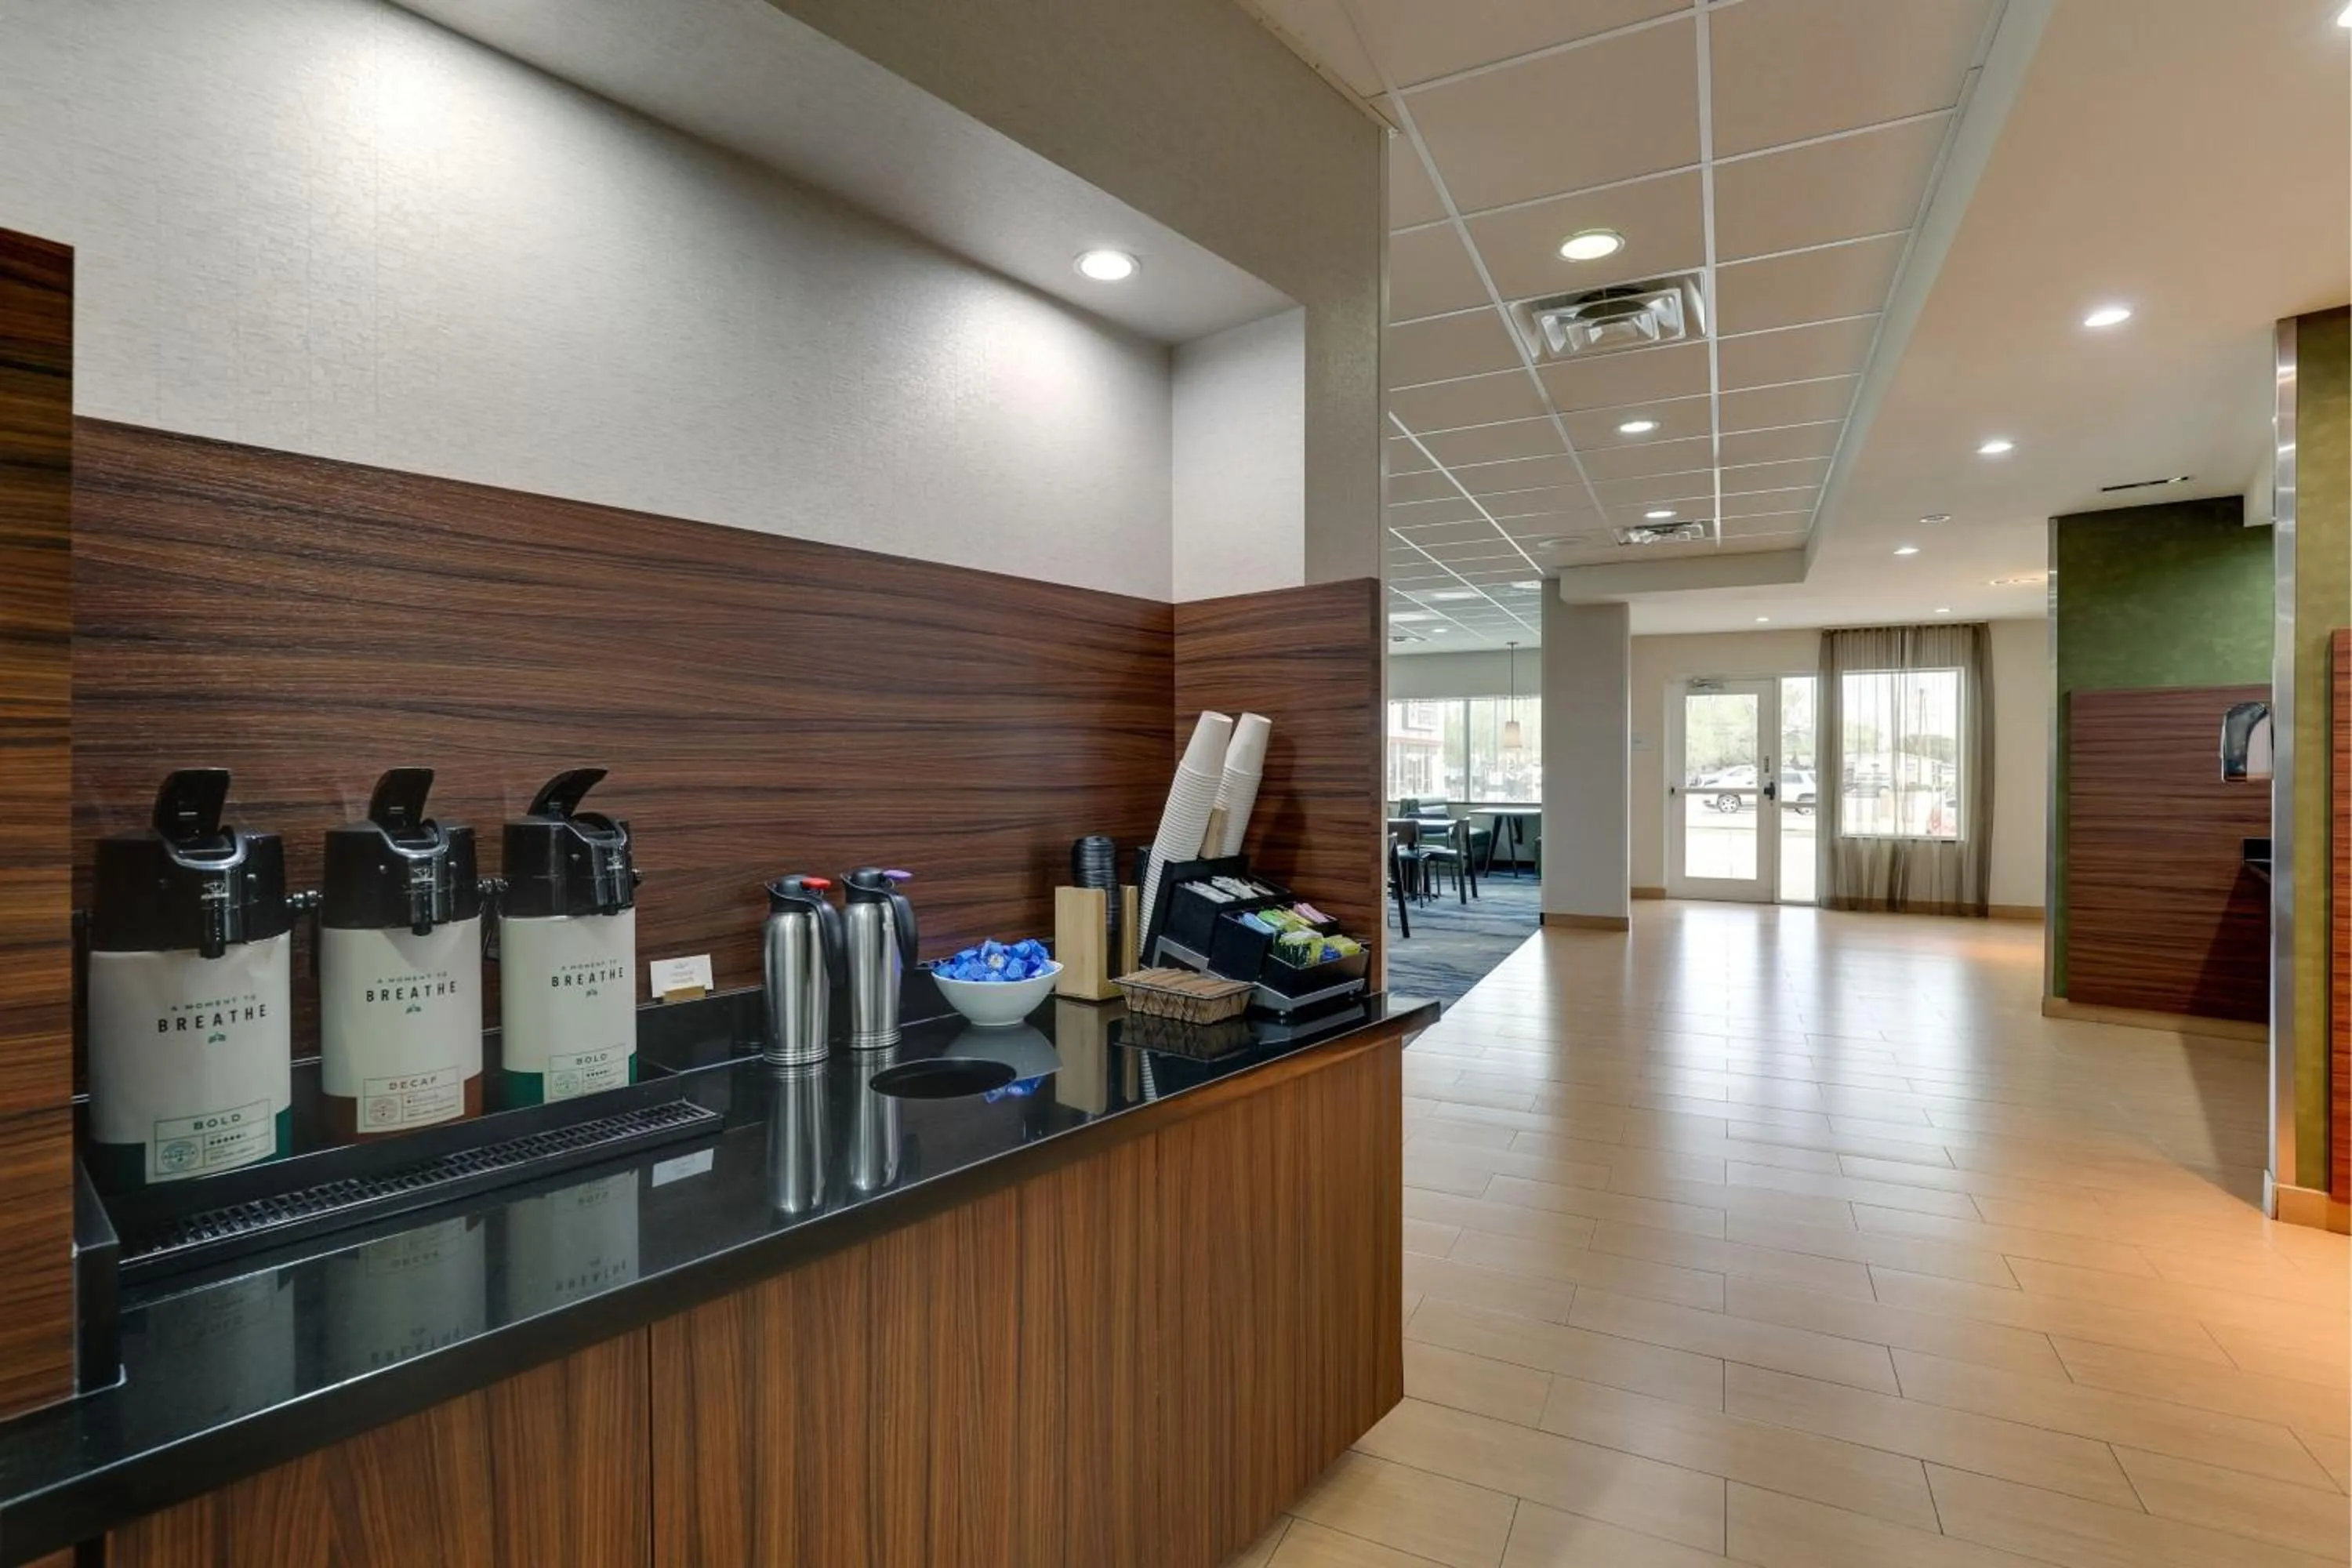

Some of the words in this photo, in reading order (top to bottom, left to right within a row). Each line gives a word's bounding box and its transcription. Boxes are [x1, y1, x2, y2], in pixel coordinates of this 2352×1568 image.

[551, 967, 624, 987] BREATHE
[365, 981, 456, 1003] BREATHE
[158, 1004, 267, 1033] BREATHE
[576, 1053, 608, 1065] BOLD
[388, 1076, 437, 1091] DECAF
[193, 1113, 241, 1131] BOLD
